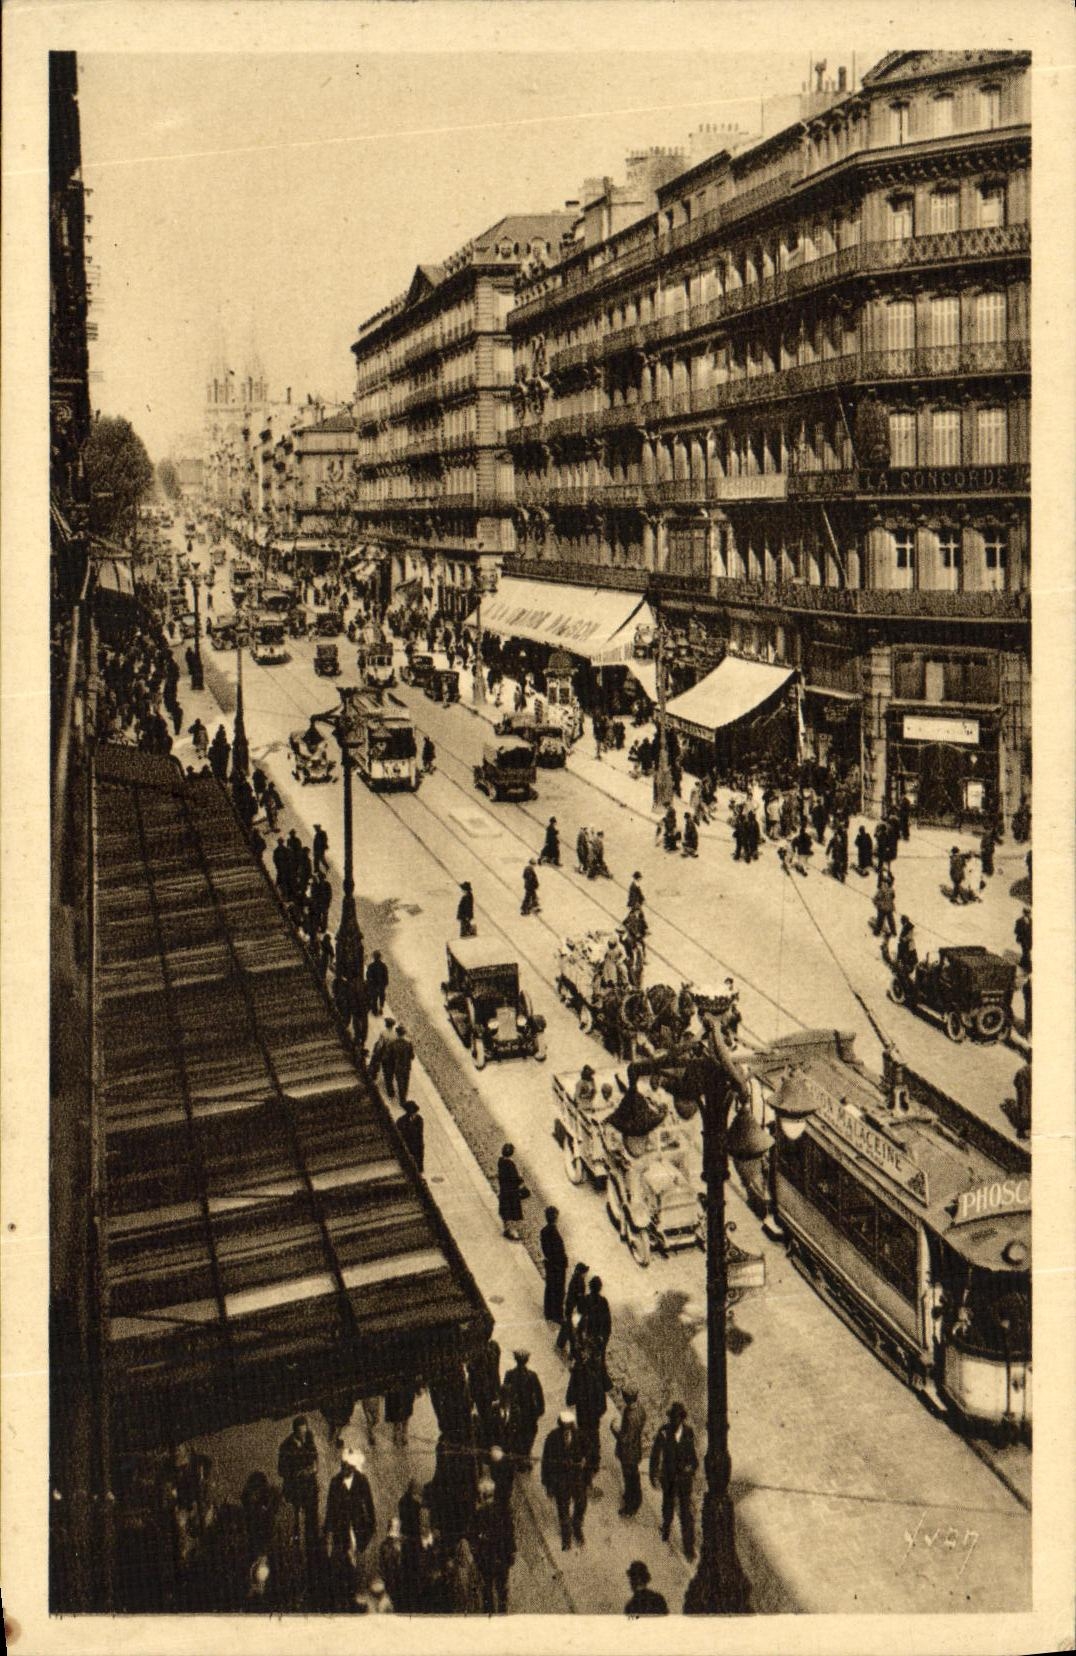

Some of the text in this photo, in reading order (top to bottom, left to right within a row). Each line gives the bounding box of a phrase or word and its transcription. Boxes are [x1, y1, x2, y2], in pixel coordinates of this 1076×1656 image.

[866, 468, 1008, 491] LA CONCORDE
[962, 1180, 1031, 1217] PHOSC
